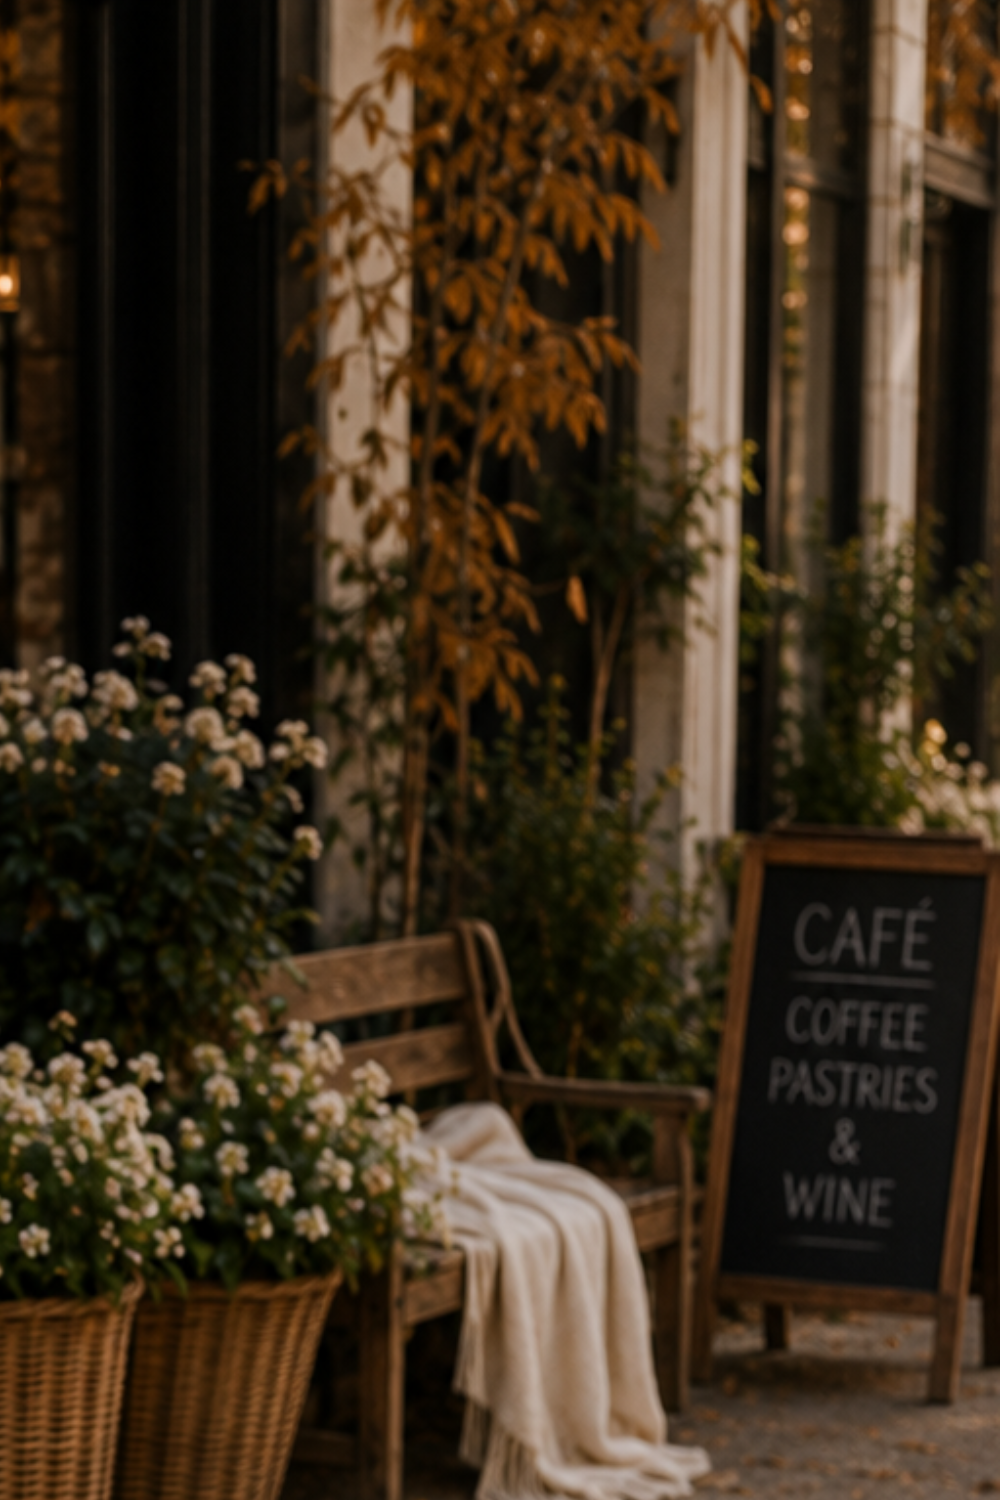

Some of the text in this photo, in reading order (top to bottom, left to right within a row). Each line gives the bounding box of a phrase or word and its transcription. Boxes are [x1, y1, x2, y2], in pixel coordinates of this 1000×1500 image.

[793, 897, 938, 971] CAFÉ
[784, 995, 929, 1053] COFFEE
[767, 1056, 939, 1115] PASTRIES
[828, 1117, 861, 1166] &
[783, 1171, 896, 1229] WINE
